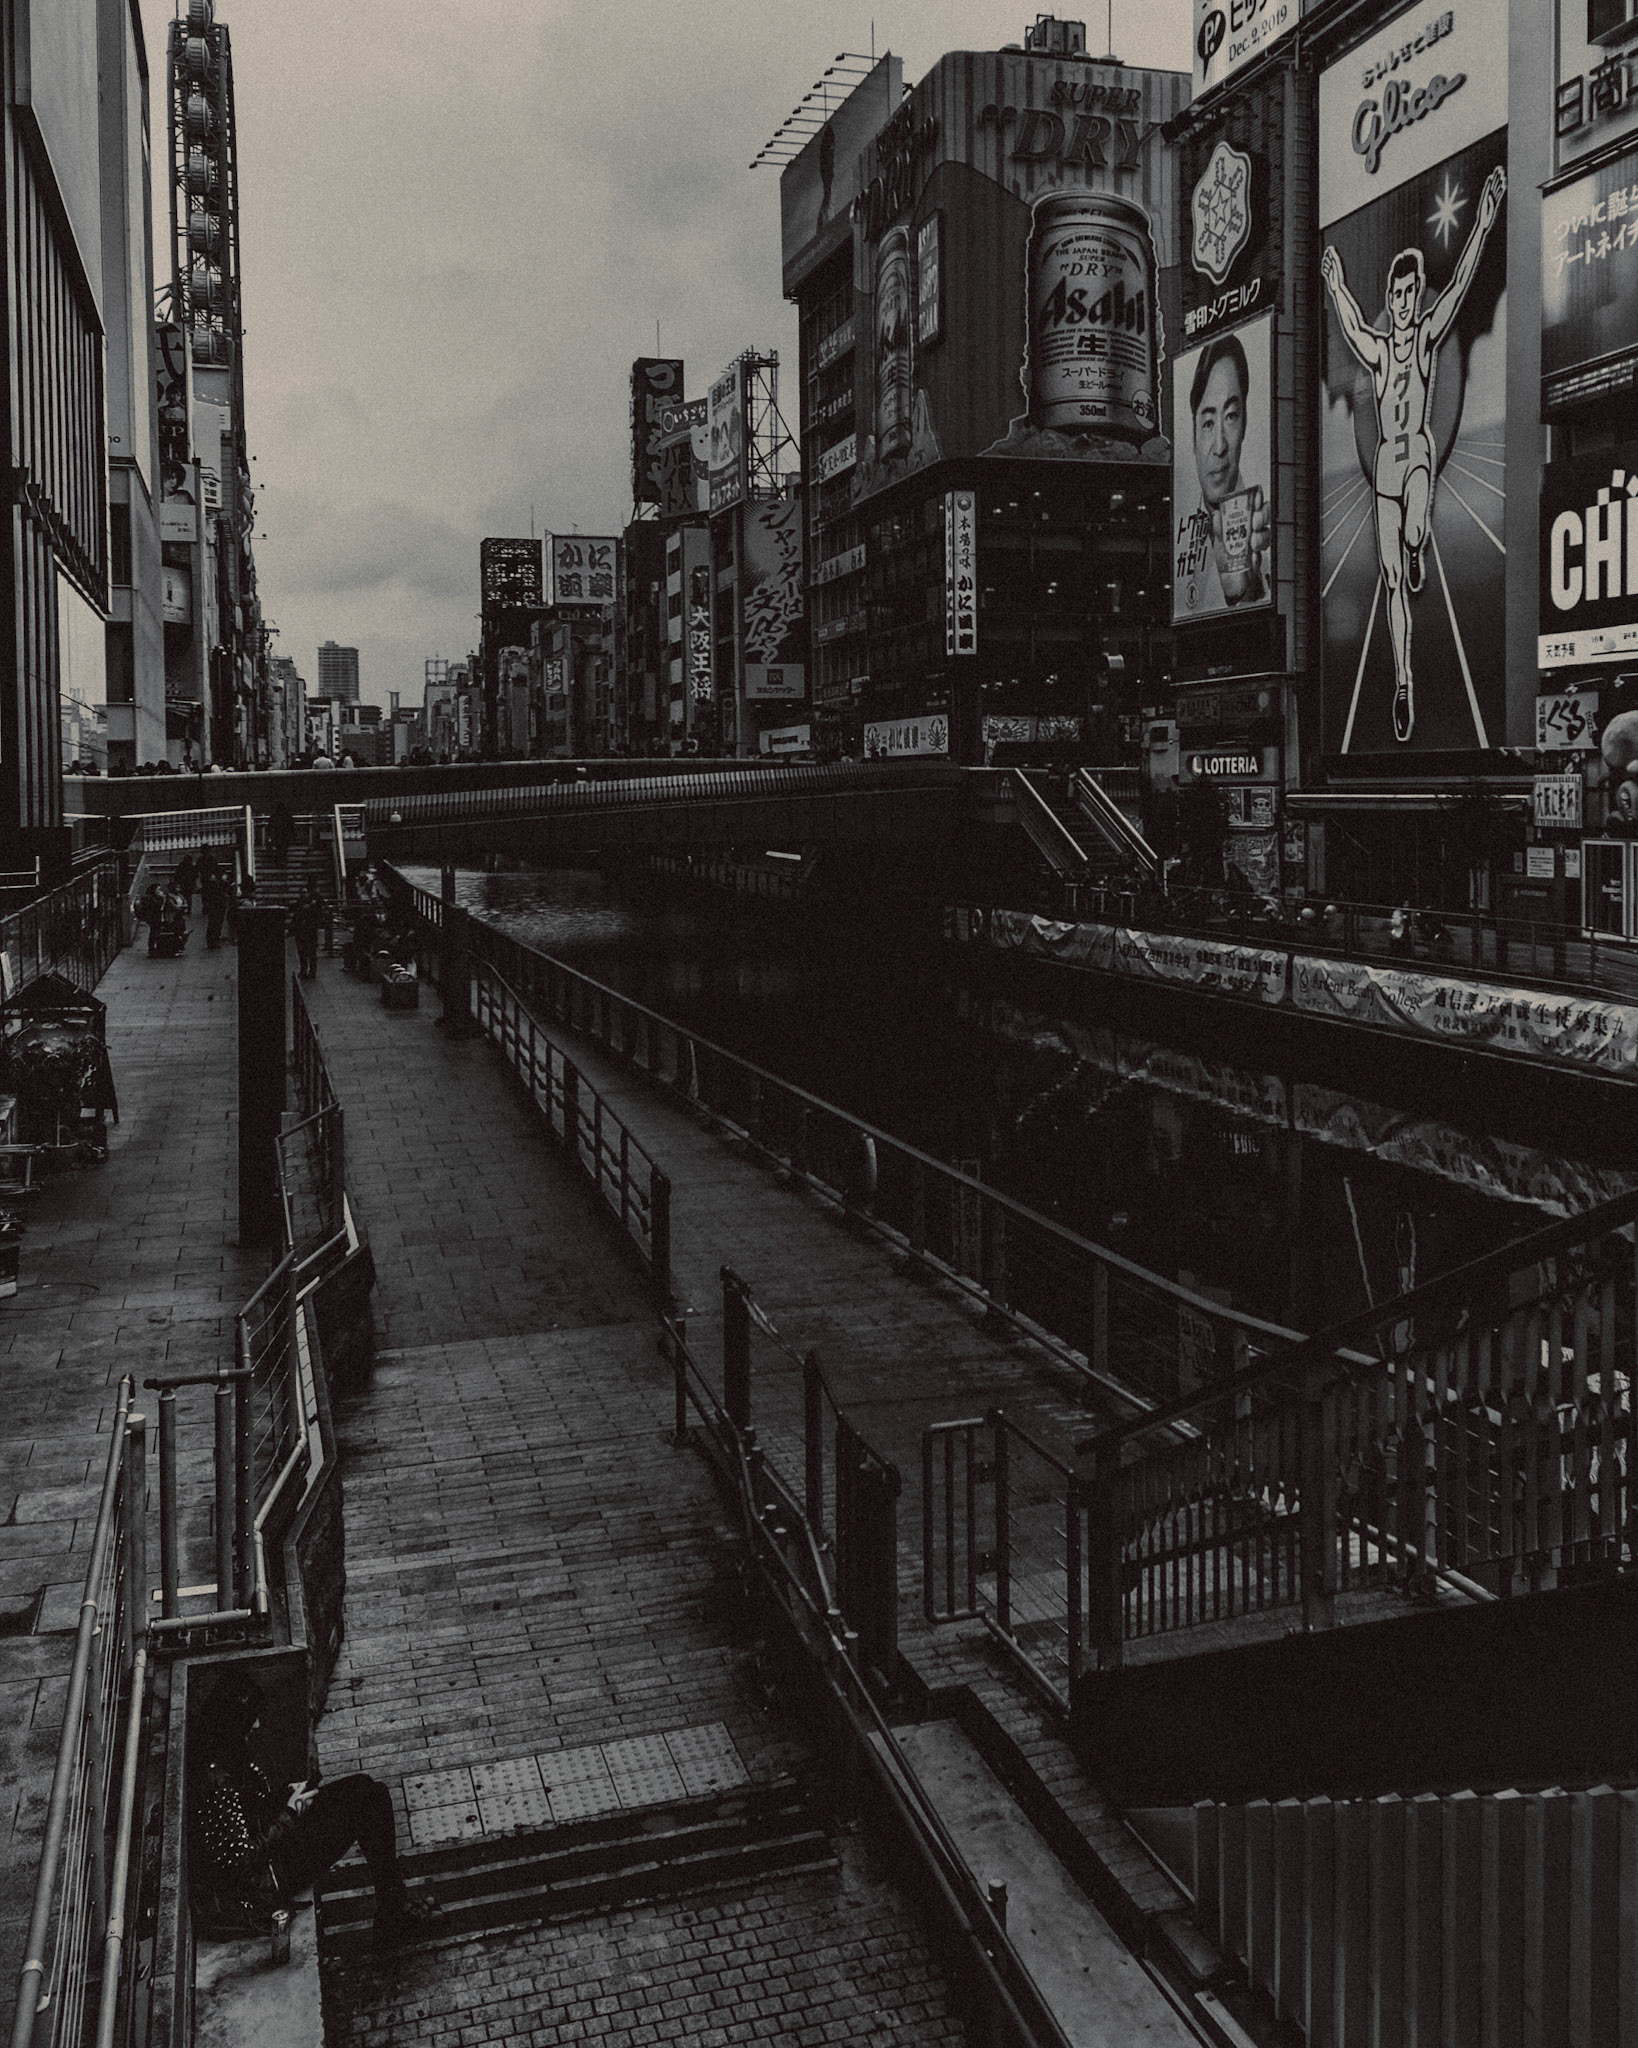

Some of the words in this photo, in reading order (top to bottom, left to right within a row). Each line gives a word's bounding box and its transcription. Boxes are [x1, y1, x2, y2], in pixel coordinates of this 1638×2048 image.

[1050, 79, 1142, 113] SUPER
[1055, 249, 1070, 257] THE
[1071, 247, 1098, 255] JAPAN
[1101, 249, 1128, 262] BRAND
[1078, 254, 1107, 263] SUPER
[1040, 276, 1146, 336] Asahi
[1184, 277, 1261, 336] 雪印メグミルク
[1076, 333, 1109, 357] 生
[1061, 366, 1126, 382] スーパードライ
[1079, 404, 1107, 417] 350ml
[1393, 363, 1412, 464] グリコ
[557, 542, 612, 570] かに
[758, 502, 802, 617] シャッターは
[688, 604, 713, 701] 大阪王将
[1546, 699, 1586, 742] くくる
[1204, 755, 1259, 775] LOTTERIA
